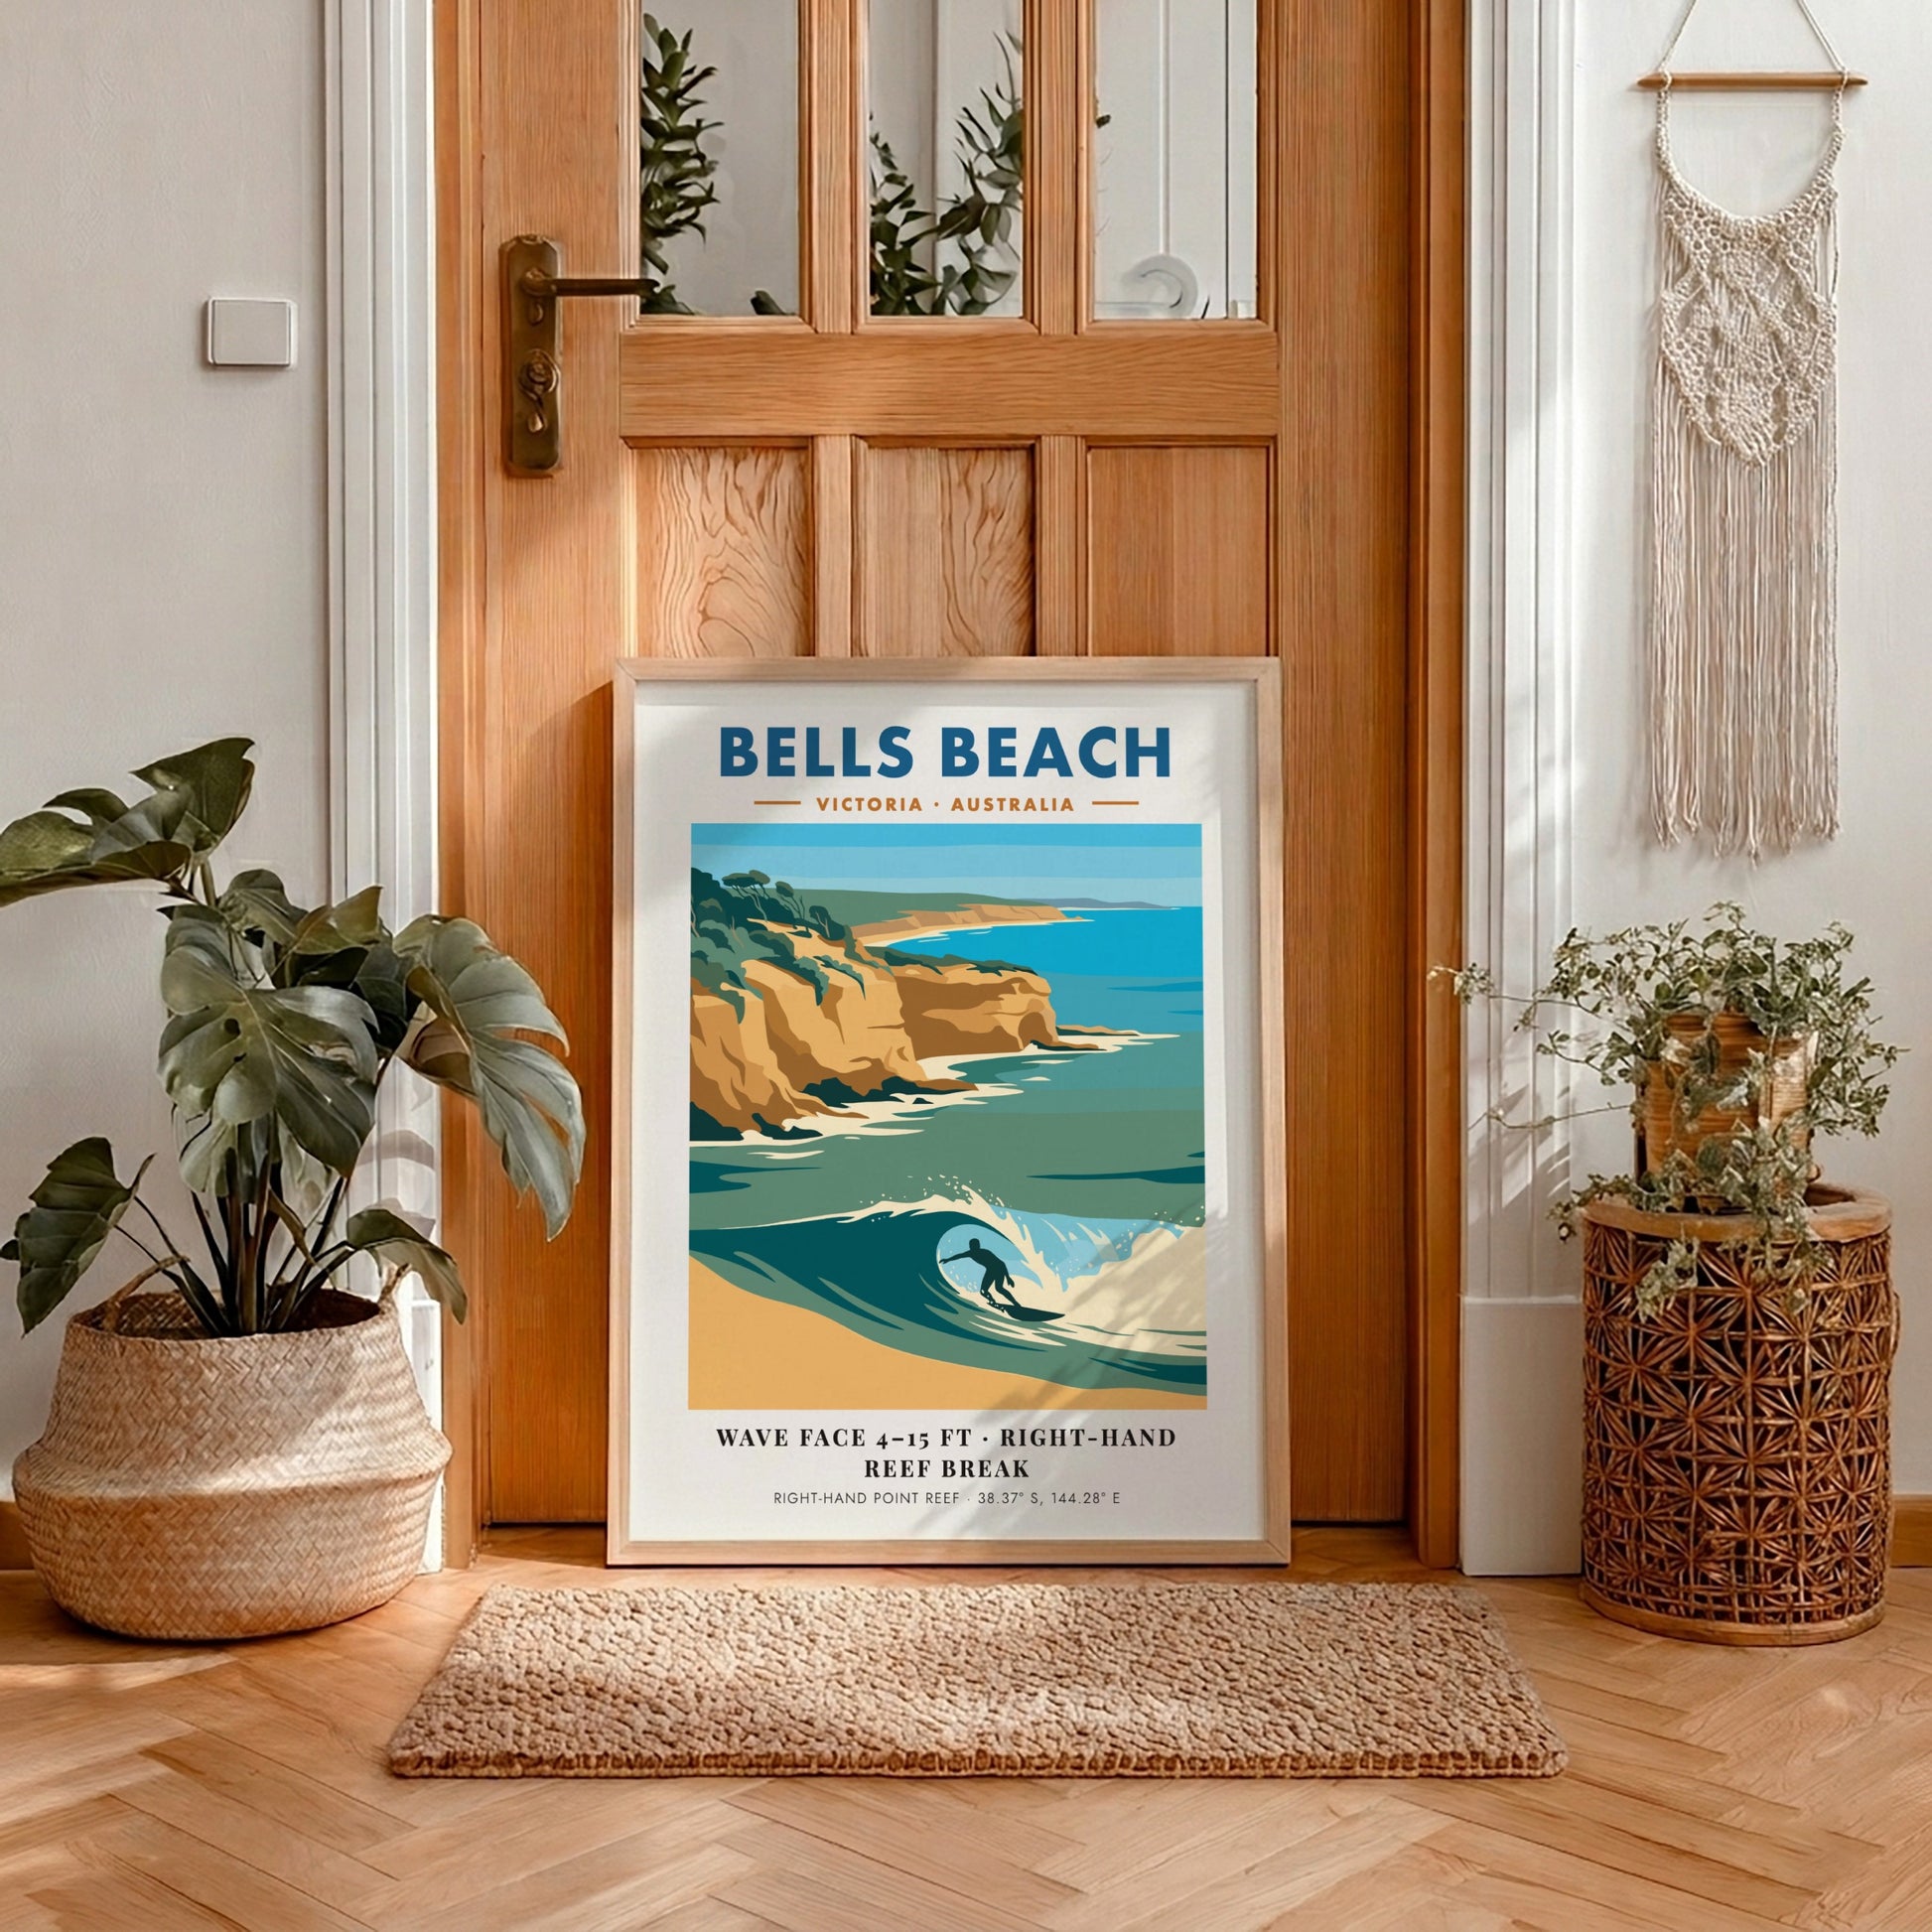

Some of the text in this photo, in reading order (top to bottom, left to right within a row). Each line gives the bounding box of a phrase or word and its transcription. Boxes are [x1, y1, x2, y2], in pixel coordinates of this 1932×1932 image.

[720, 726, 1171, 779] BELLS BEACH
[816, 796, 1074, 812] VICTORIA AUSTRALIA
[716, 1428, 788, 1448] WAVE
[799, 1428, 866, 1448] FACE
[939, 1428, 972, 1448] FT
[1000, 1428, 1176, 1448] RIGHT-HAND
[864, 1459, 1030, 1478] REEF BREAK
[773, 1491, 1121, 1506] RIGHT-HAND POINT REEF 38.37° S, 144.28° E
